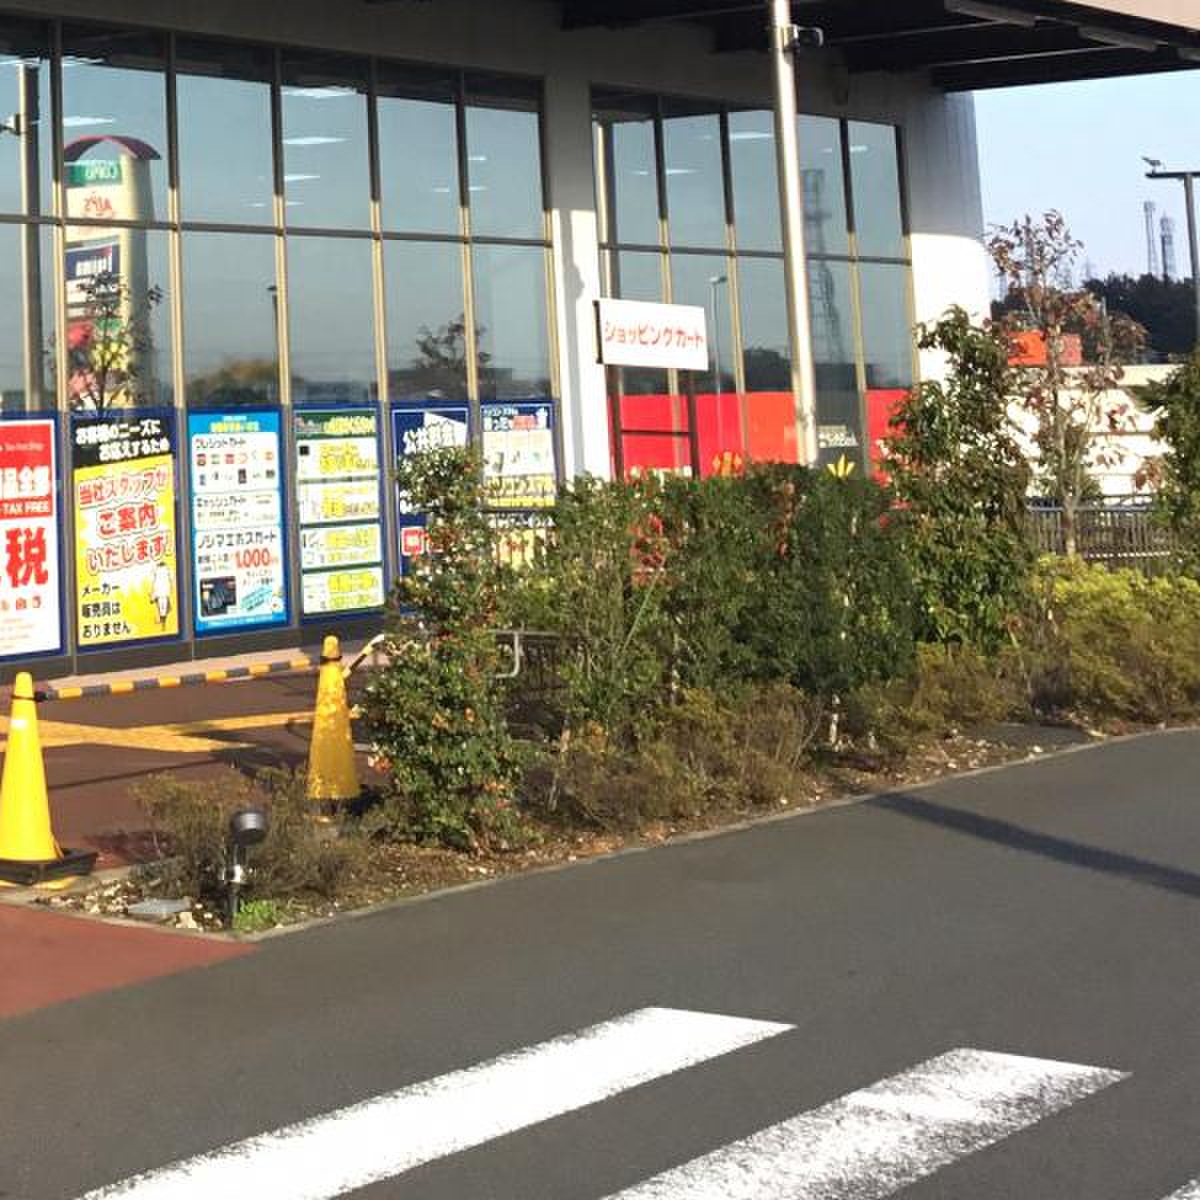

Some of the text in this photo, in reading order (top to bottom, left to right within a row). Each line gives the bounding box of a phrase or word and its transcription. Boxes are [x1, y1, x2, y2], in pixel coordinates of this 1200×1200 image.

[604, 320, 704, 349] ショッピングカート
[98, 502, 158, 536] ご案内
